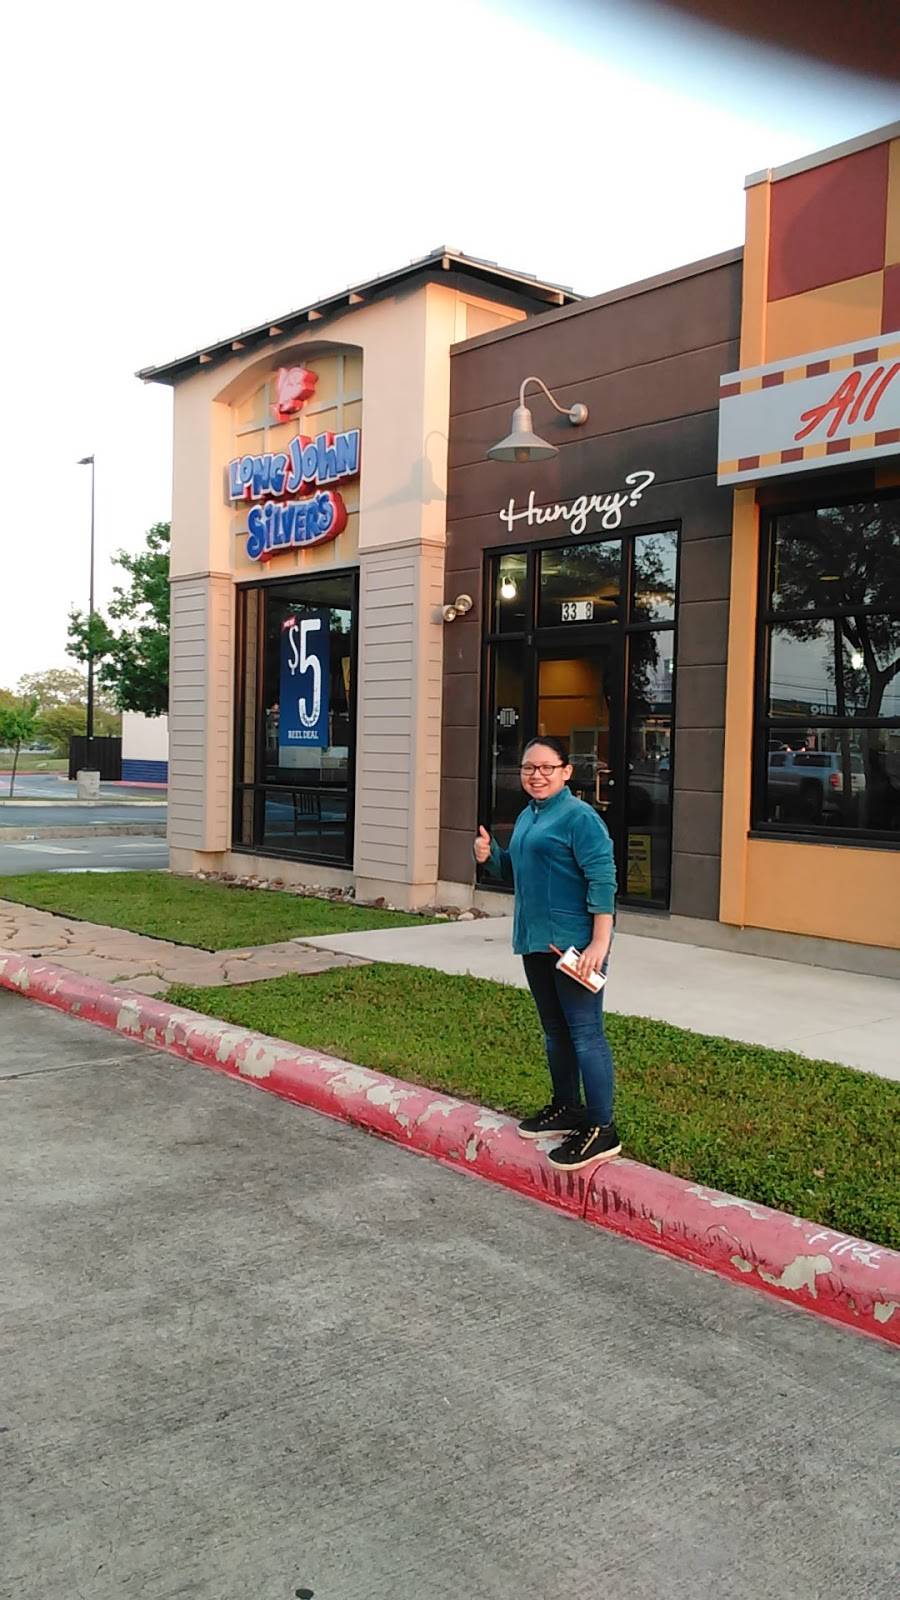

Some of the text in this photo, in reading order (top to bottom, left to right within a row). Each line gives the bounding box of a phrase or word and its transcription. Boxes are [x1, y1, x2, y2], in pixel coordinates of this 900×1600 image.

[794, 362, 900, 442] All
[499, 470, 656, 536] Hungry?
[808, 1231, 899, 1269] FIRE
